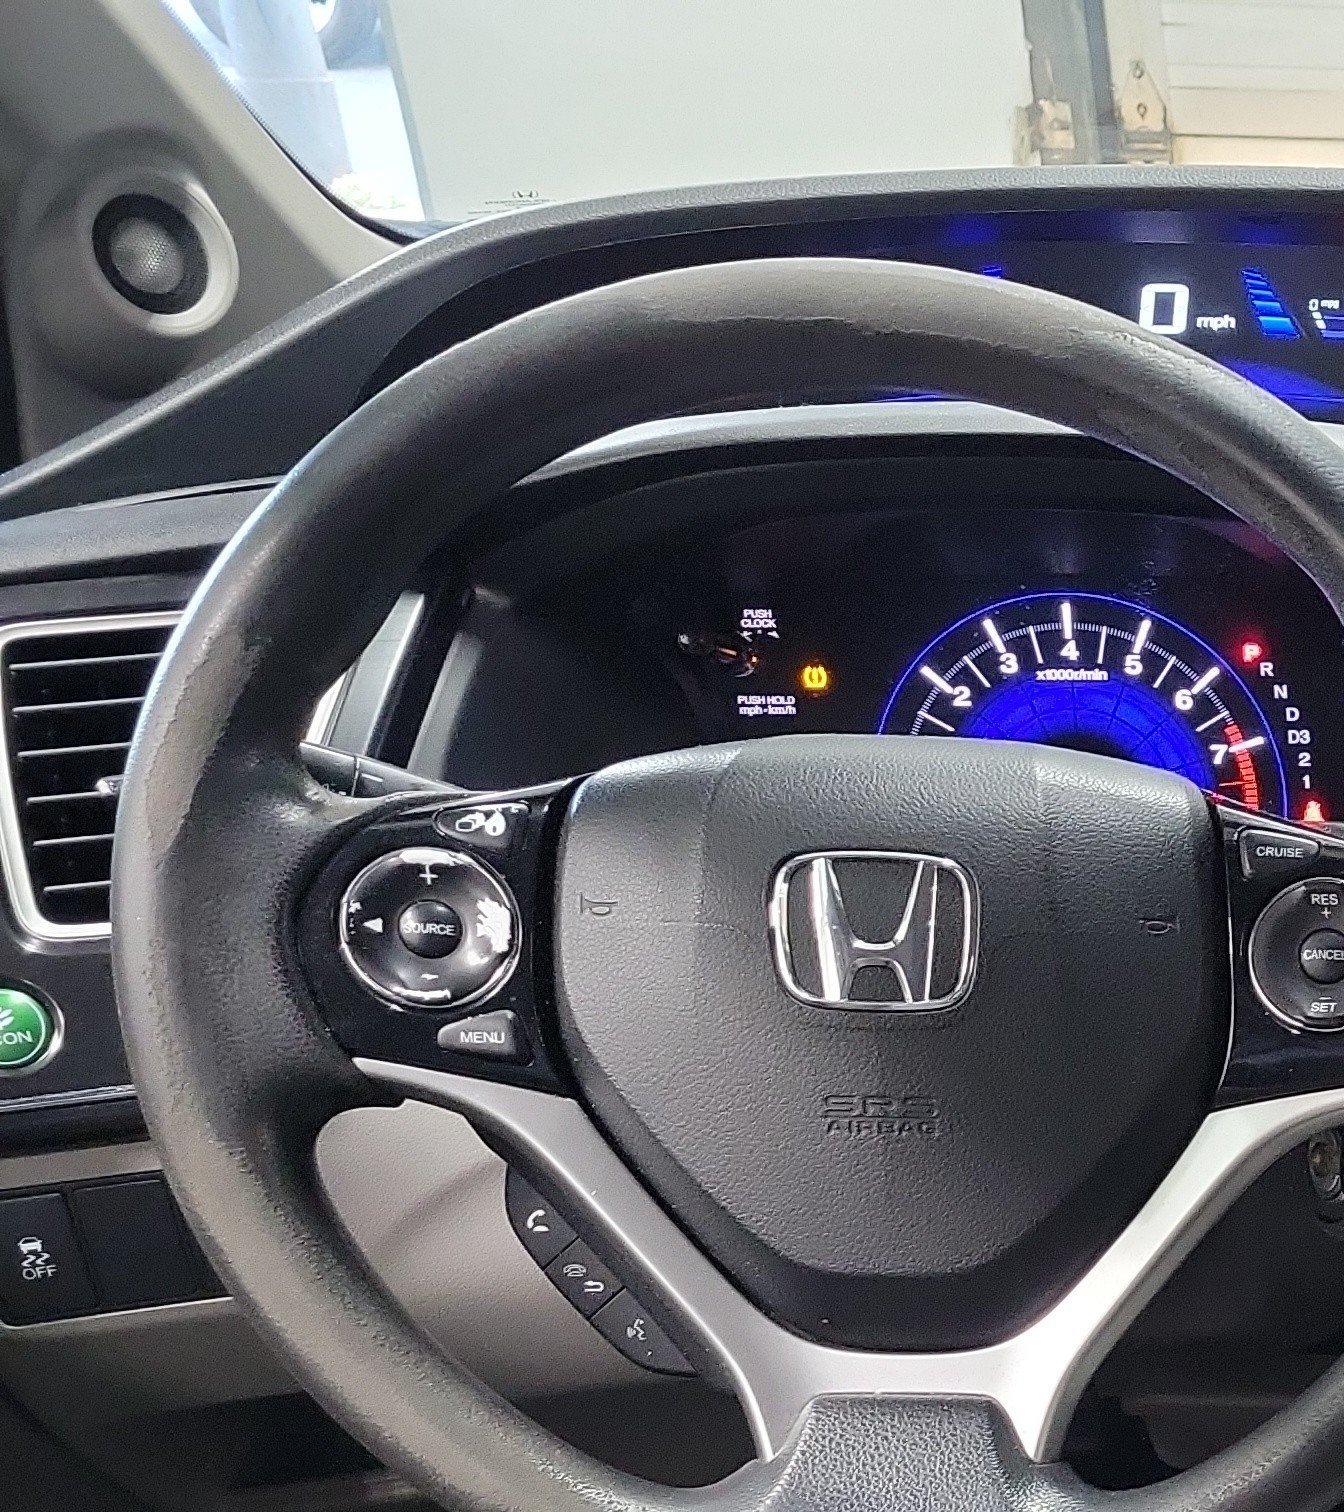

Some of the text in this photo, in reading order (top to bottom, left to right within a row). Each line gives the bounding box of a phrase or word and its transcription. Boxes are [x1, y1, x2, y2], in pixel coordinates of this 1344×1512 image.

[1139, 283, 1236, 335] 0 mph
[1309, 299, 1319, 311] 0
[743, 609, 772, 618] PUSH
[740, 619, 777, 628] CLOCK
[1061, 639, 1079, 659] 4
[1243, 643, 1260, 662] P
[1001, 655, 1018, 674] 3
[1124, 656, 1142, 675] 5
[1260, 662, 1274, 677] R
[1036, 669, 1108, 681] x1000r/min
[953, 688, 972, 708] 2
[1274, 684, 1289, 700] N
[737, 695, 796, 705] PUSH HOLD
[1176, 690, 1194, 710] 6
[1286, 707, 1300, 722] D
[1288, 729, 1311, 744] D3
[1210, 745, 1228, 764] 7
[1299, 752, 1311, 766] 2
[1304, 776, 1311, 790] 1
[1256, 846, 1304, 859] CRUISE
[1311, 894, 1339, 906] RES
[404, 923, 455, 936] SOURCE
[1310, 1001, 1338, 1014] SET
[0, 1030, 33, 1045] ON
[460, 1031, 506, 1044] MENU
[22, 1264, 57, 1279] OFF
